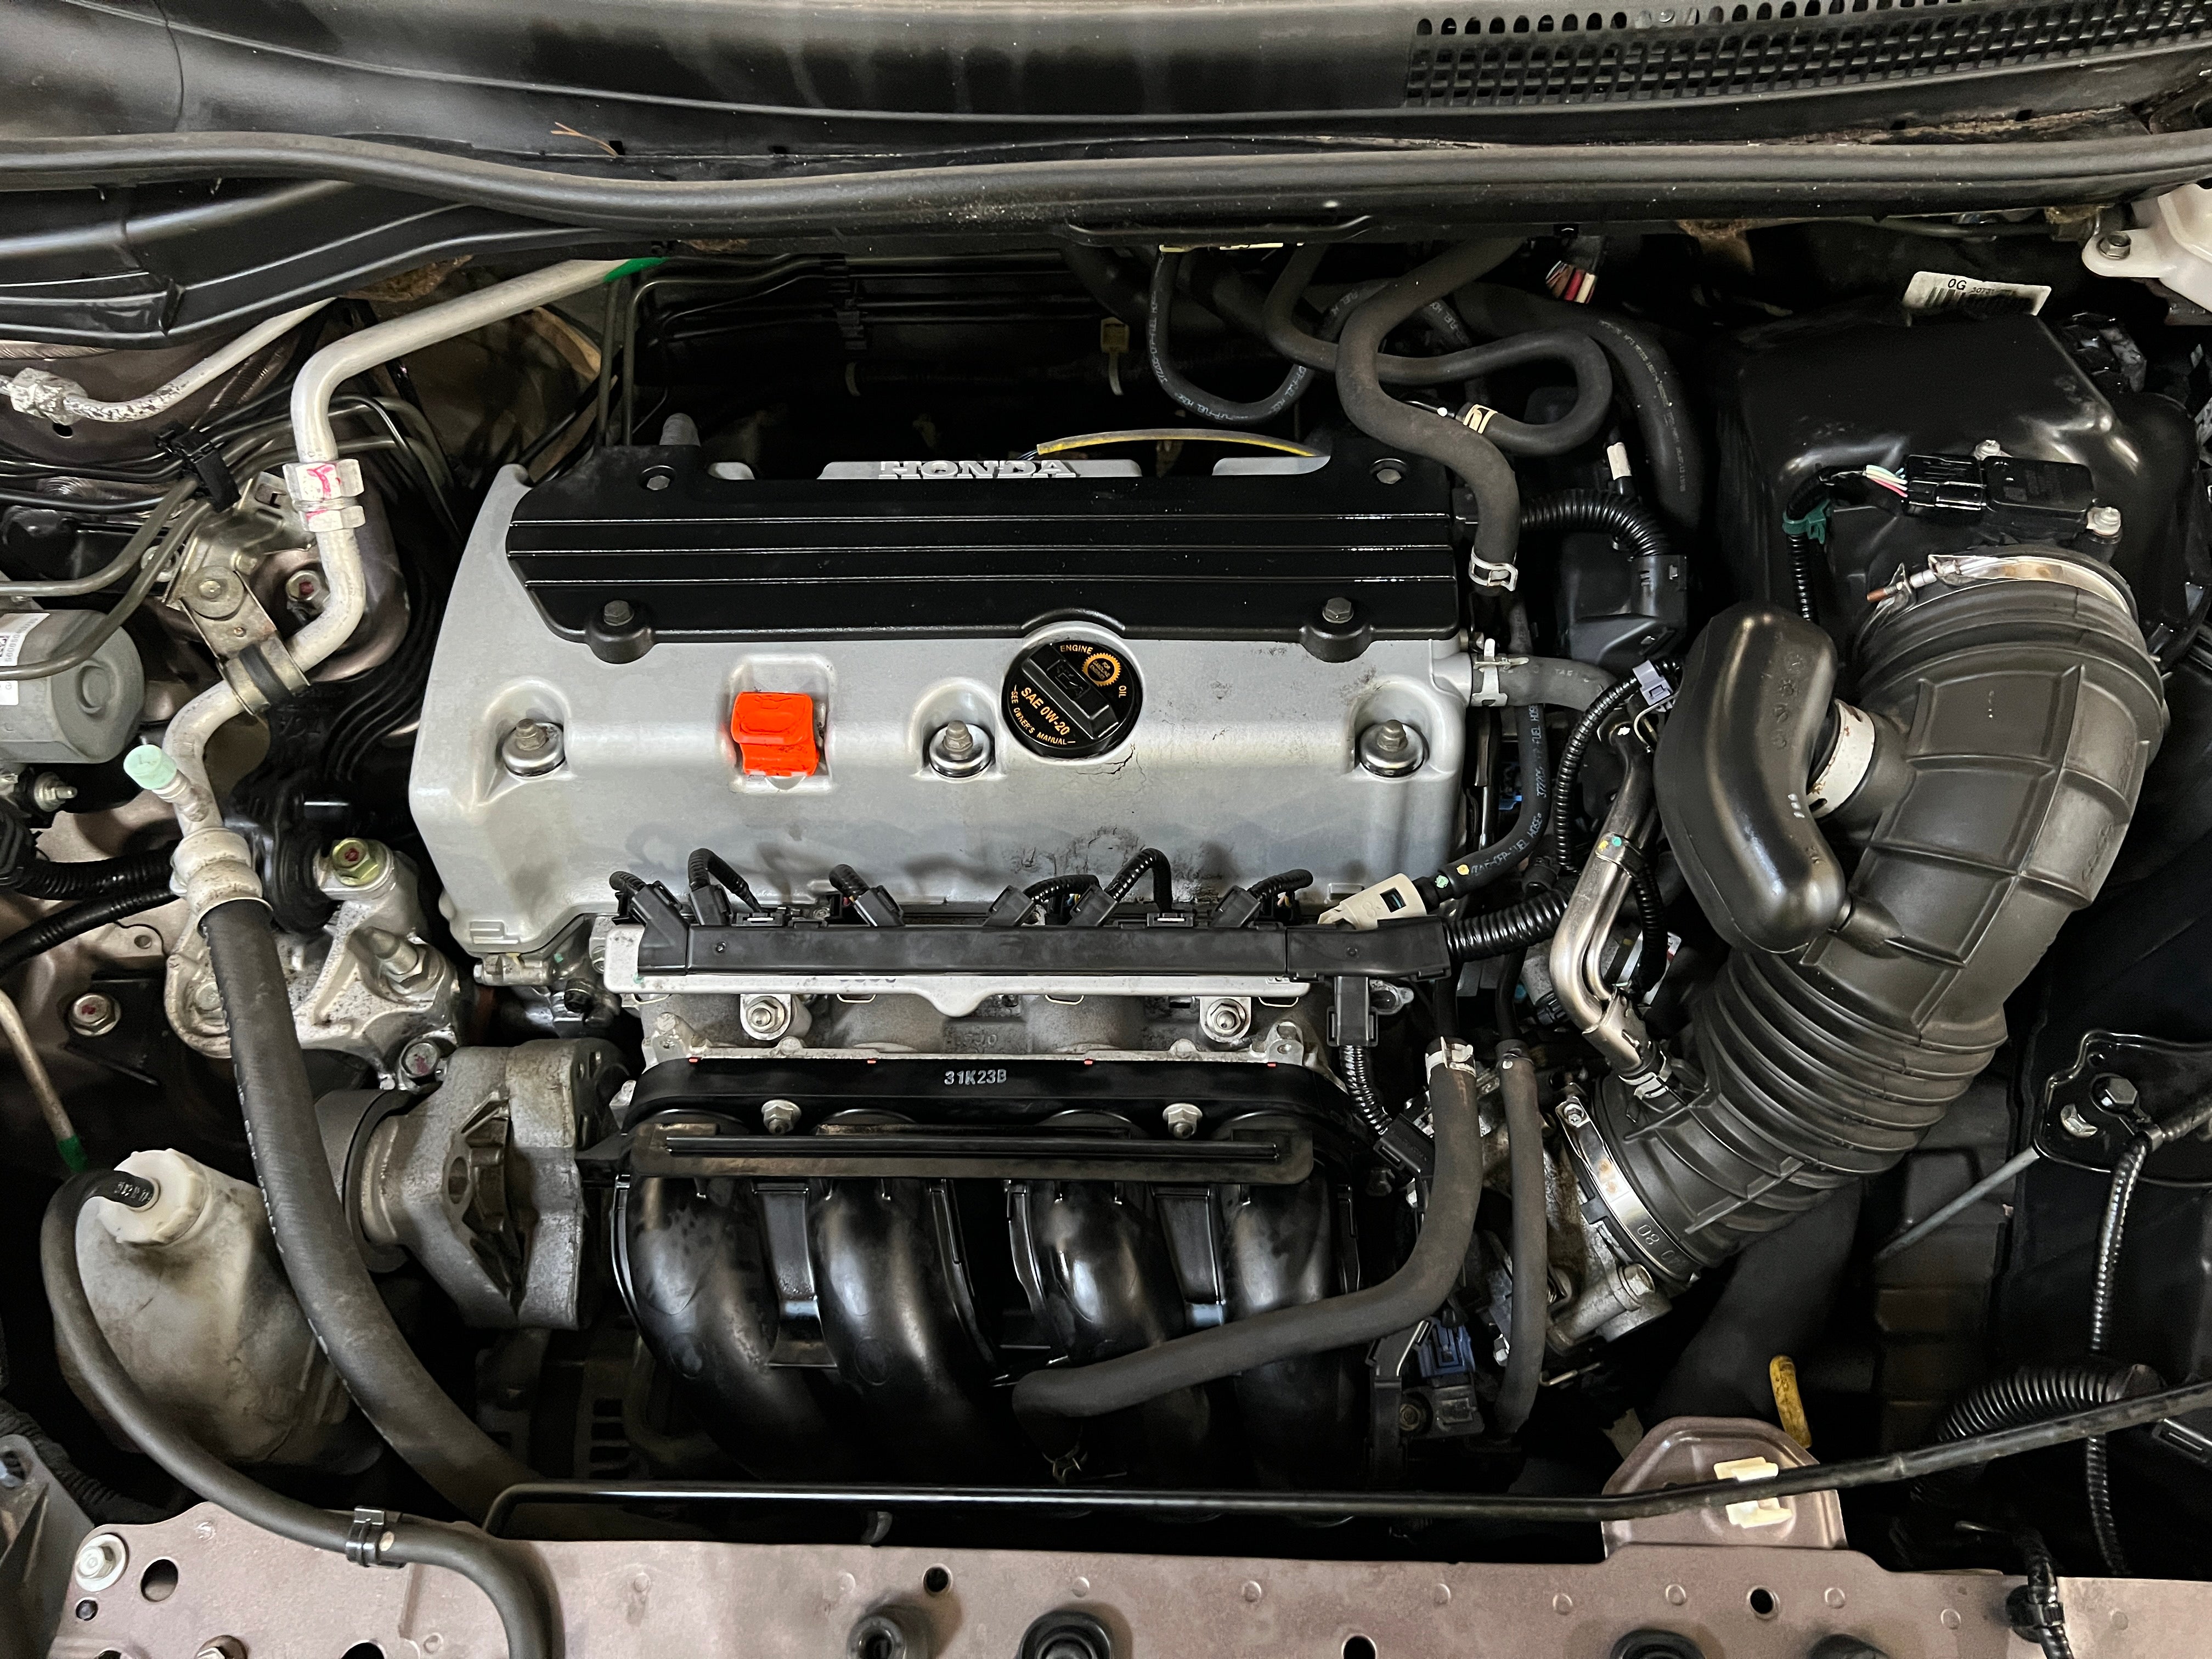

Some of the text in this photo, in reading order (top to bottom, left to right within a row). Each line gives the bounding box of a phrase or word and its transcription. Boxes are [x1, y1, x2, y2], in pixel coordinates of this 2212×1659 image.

[878, 460, 1076, 479] HONDA
[1060, 644, 1093, 655] ENGINE
[1118, 685, 1127, 698] OIL
[1021, 687, 1070, 735] SAE 0W-20
[1036, 731, 1068, 745] MANUAL
[944, 1069, 1007, 1085] 31K23B
